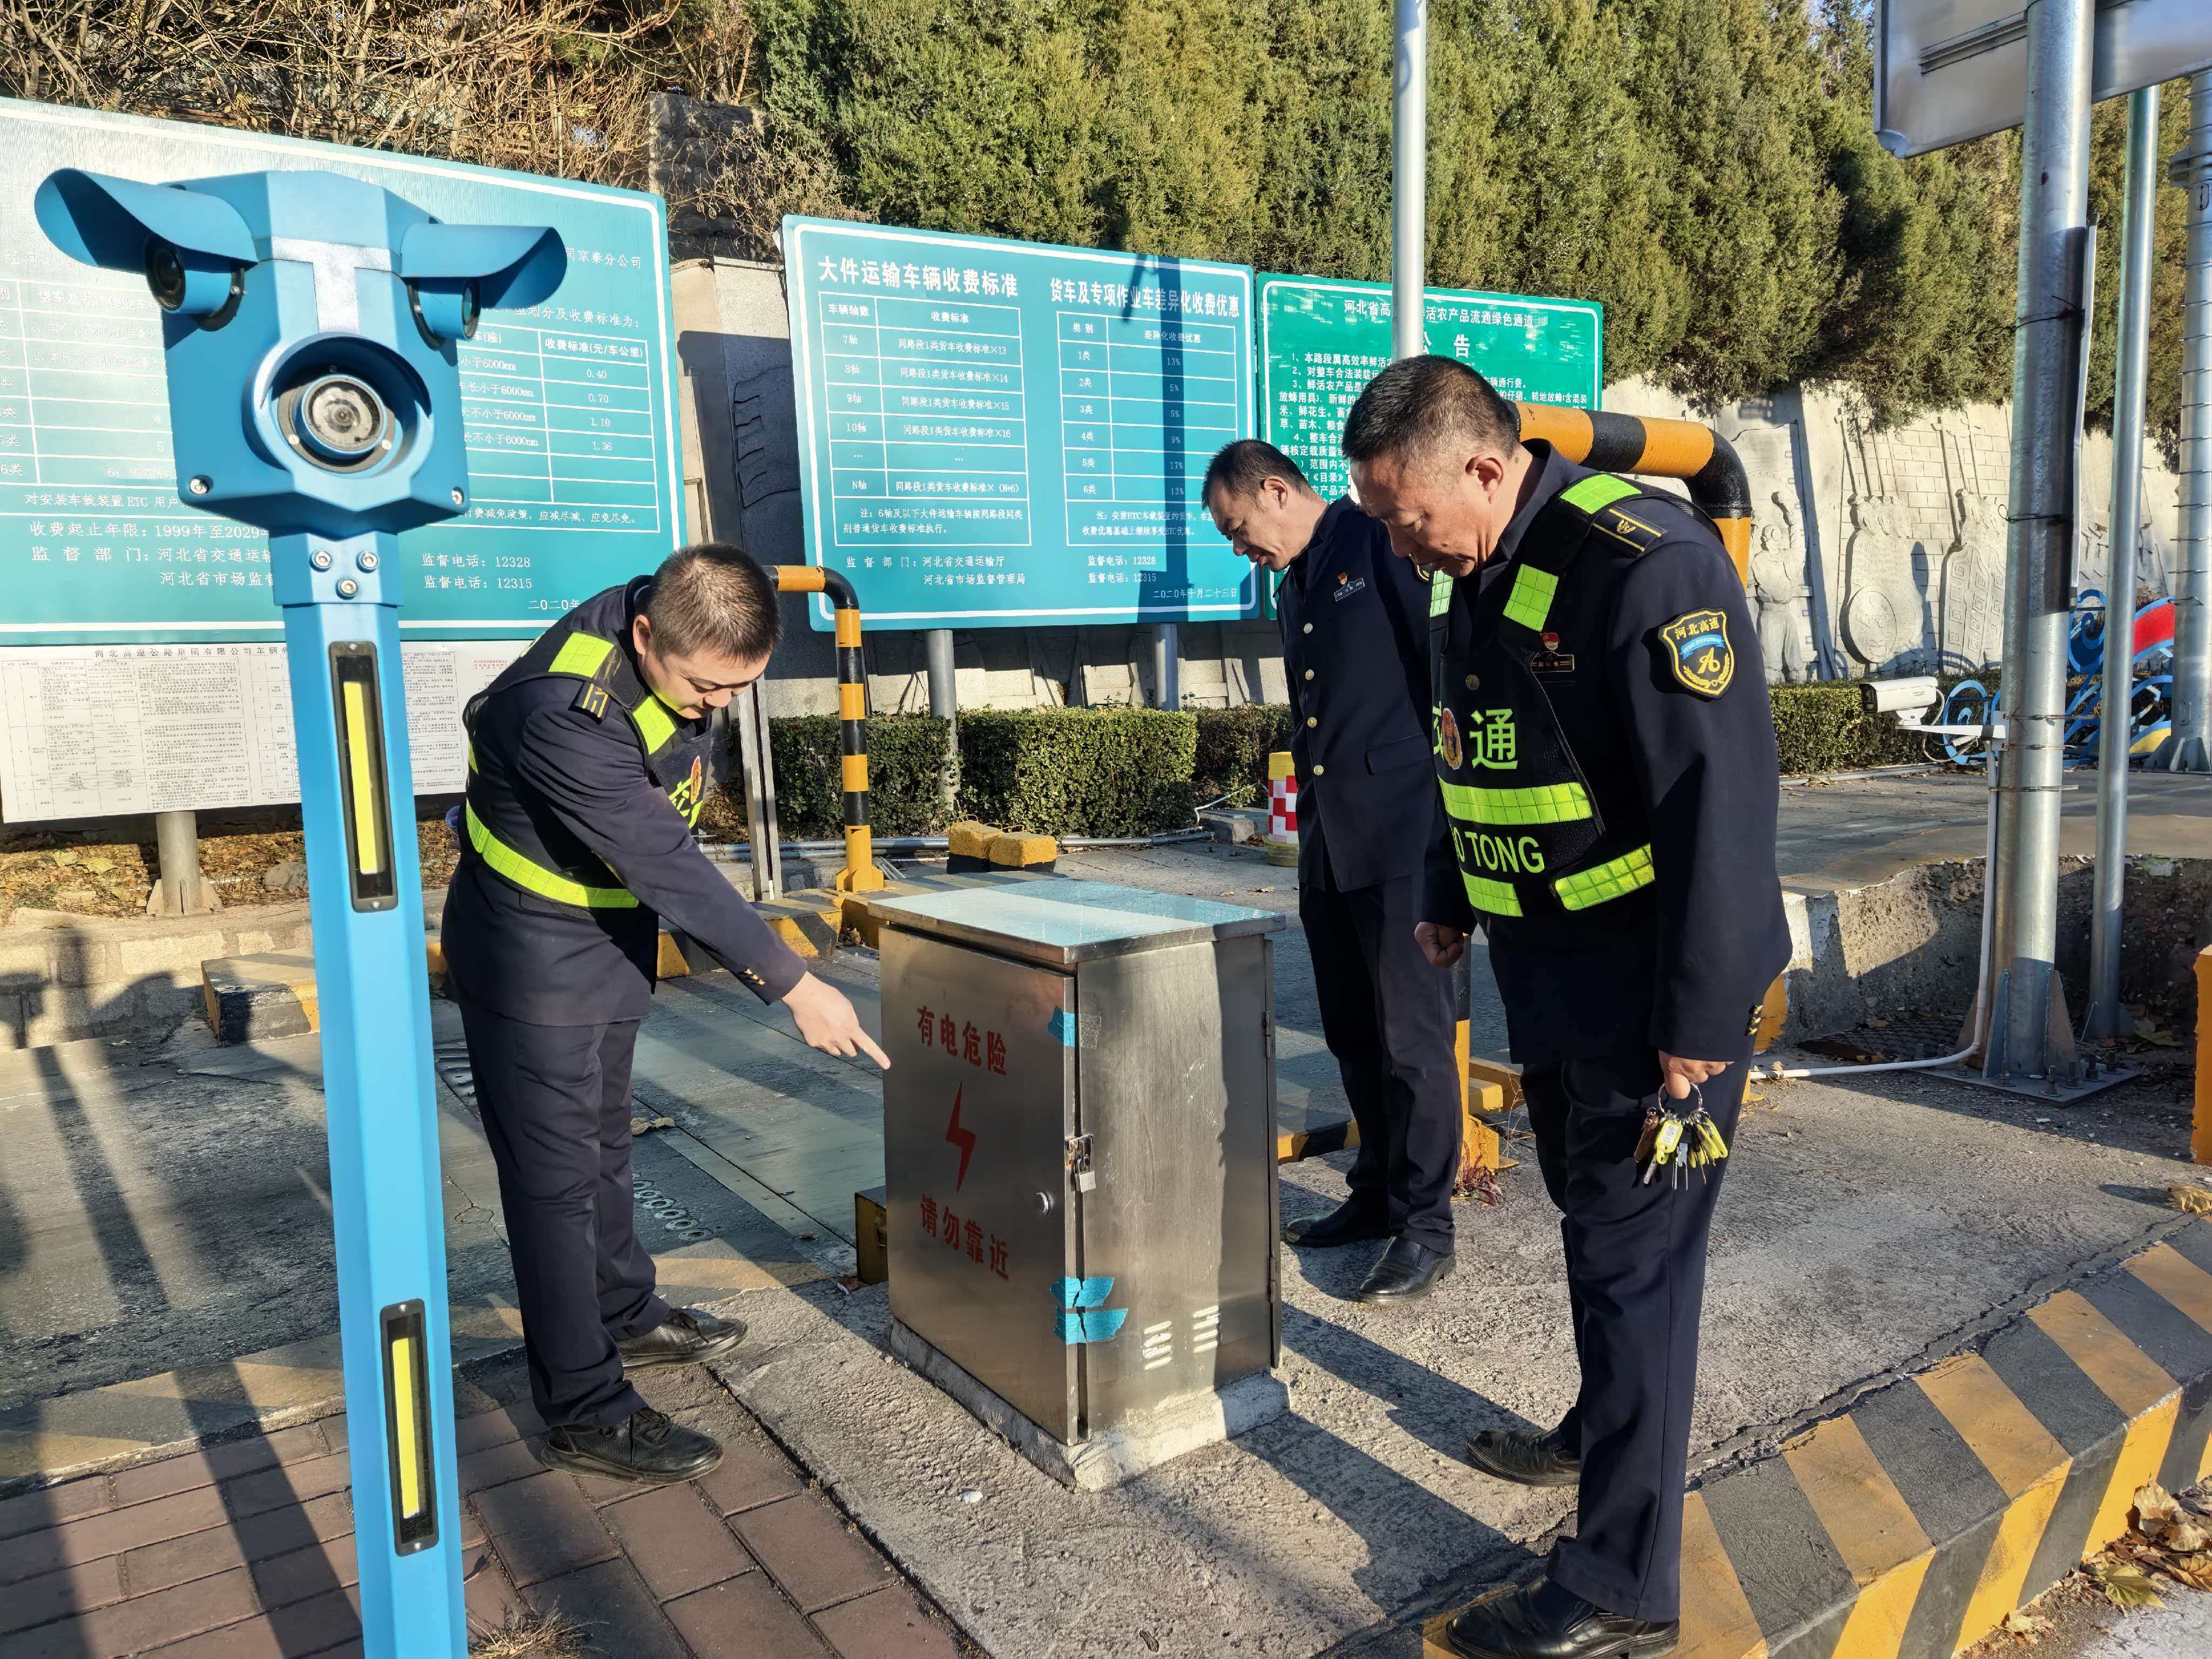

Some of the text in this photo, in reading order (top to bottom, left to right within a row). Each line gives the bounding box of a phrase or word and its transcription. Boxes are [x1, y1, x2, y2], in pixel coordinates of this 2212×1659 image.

[818, 255, 1019, 299] 大件运输车辆收费标准
[1050, 276, 1240, 319] 货车及专项作业车差异化收费优惠
[828, 302, 870, 318] 车辆轴数
[930, 311, 970, 324] 收费标准
[1423, 306, 1533, 328] 活农产品流通绿色通道
[1144, 329, 1202, 345] 差异化收费优惠
[544, 338, 643, 358] 收费标准(元/车公里)
[1453, 333, 1471, 359] 告
[1078, 349, 1091, 361] 1类
[458, 355, 516, 372] 小于6000mm
[1166, 357, 1181, 366] 13%
[586, 368, 607, 380] 0.40
[1078, 376, 1092, 389] 2类
[1169, 384, 1179, 393] 5%
[588, 393, 609, 404] 0.70
[846, 393, 862, 404] 9轴
[1080, 403, 1094, 415] 3类
[1170, 409, 1180, 419] 5%
[590, 417, 611, 428] 1.10
[846, 422, 867, 434] 10轴
[1081, 430, 1095, 442] 4类
[1171, 435, 1181, 444] 9%
[592, 441, 613, 451] 1.36
[1082, 457, 1096, 468] 5类
[1169, 461, 1184, 470] 17%
[852, 480, 867, 491] N轴
[1083, 483, 1097, 495] 6类
[1170, 487, 1184, 496] 13%
[459, 507, 636, 524] 行费减免政策，应减尽减、应免尽免。
[923, 573, 1026, 586] 河北省市场监督管理局
[1464, 831, 1545, 874] TONG
[916, 1005, 1007, 1076] 有电危险
[920, 1194, 1011, 1280] 请勿靠近
